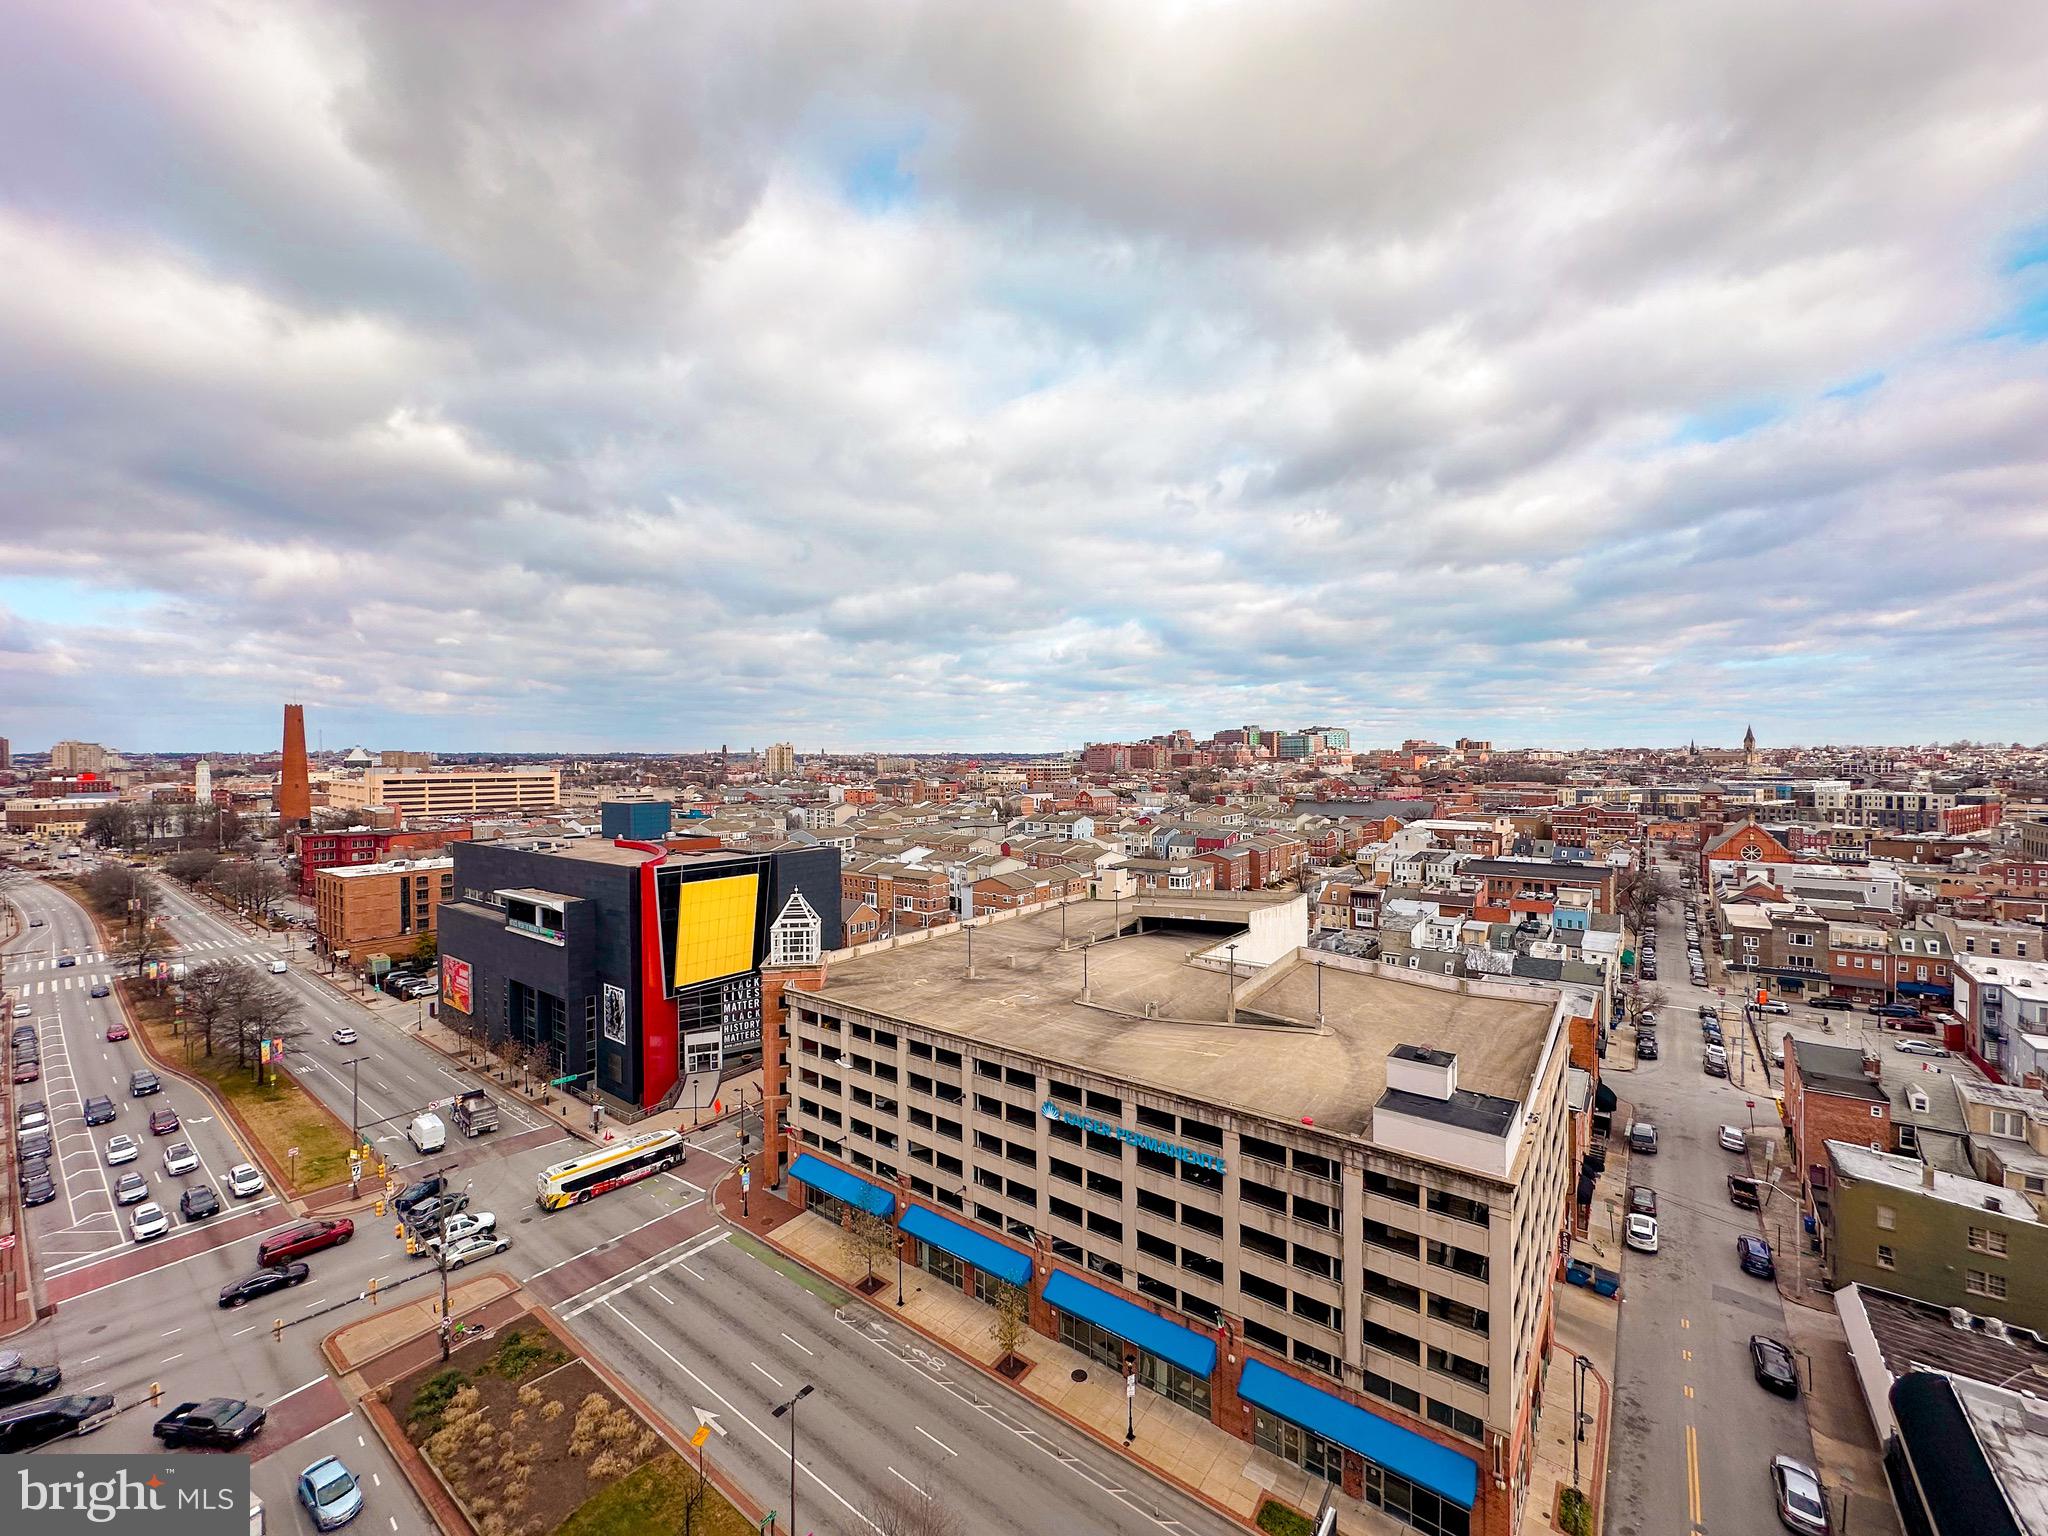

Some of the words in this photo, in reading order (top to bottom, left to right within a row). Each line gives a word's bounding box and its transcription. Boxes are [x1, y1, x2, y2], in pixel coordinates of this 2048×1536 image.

[723, 977, 760, 992] BLACK
[723, 988, 760, 1002] LIVES
[723, 998, 760, 1013] MATTER
[723, 1009, 760, 1023] BLACK
[723, 1019, 761, 1034] HISTORY
[723, 1029, 761, 1043] MATTERS
[1063, 1112, 1112, 1137] KAISER
[1116, 1127, 1227, 1175] PERMANENTE
